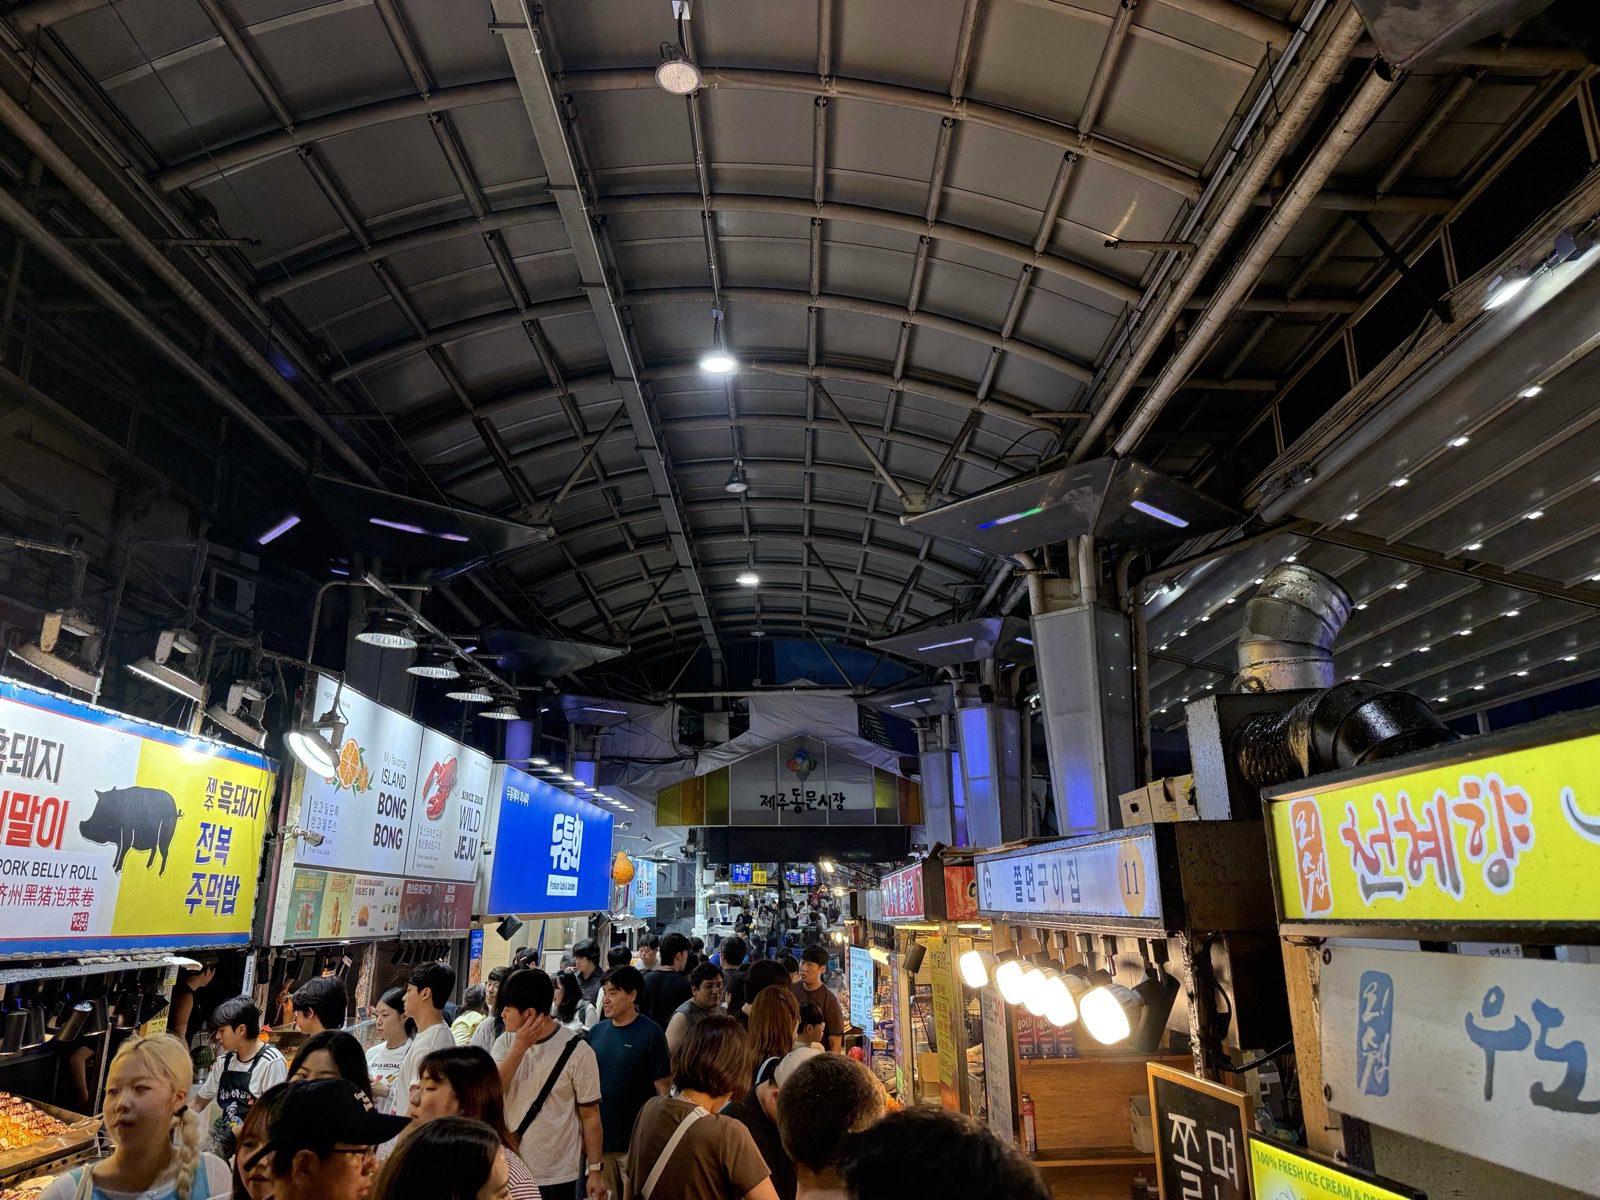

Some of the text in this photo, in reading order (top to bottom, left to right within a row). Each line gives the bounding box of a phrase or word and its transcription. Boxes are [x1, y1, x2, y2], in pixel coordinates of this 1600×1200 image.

[380, 767, 407, 790] ISLAND
[217, 781, 262, 820] 흑돼지
[376, 791, 407, 820] BONG
[461, 790, 474, 802] SINCE
[760, 788, 846, 814] 제주동문시장
[0, 790, 70, 850] 말이
[460, 804, 481, 833] WILD
[194, 822, 233, 867] 전복
[372, 823, 404, 850] BONG
[454, 834, 478, 862] JEJU
[31, 861, 69, 879] BELLY
[69, 864, 98, 881] ROLL
[1013, 857, 1140, 904] 쫄면구이집 11
[185, 872, 240, 916] 주먹밥
[1256, 1151, 1278, 1169] 100%
[1278, 1157, 1304, 1181] FRESH
[1305, 1169, 1319, 1186] ICE
[1320, 1176, 1353, 1200] CREAM
